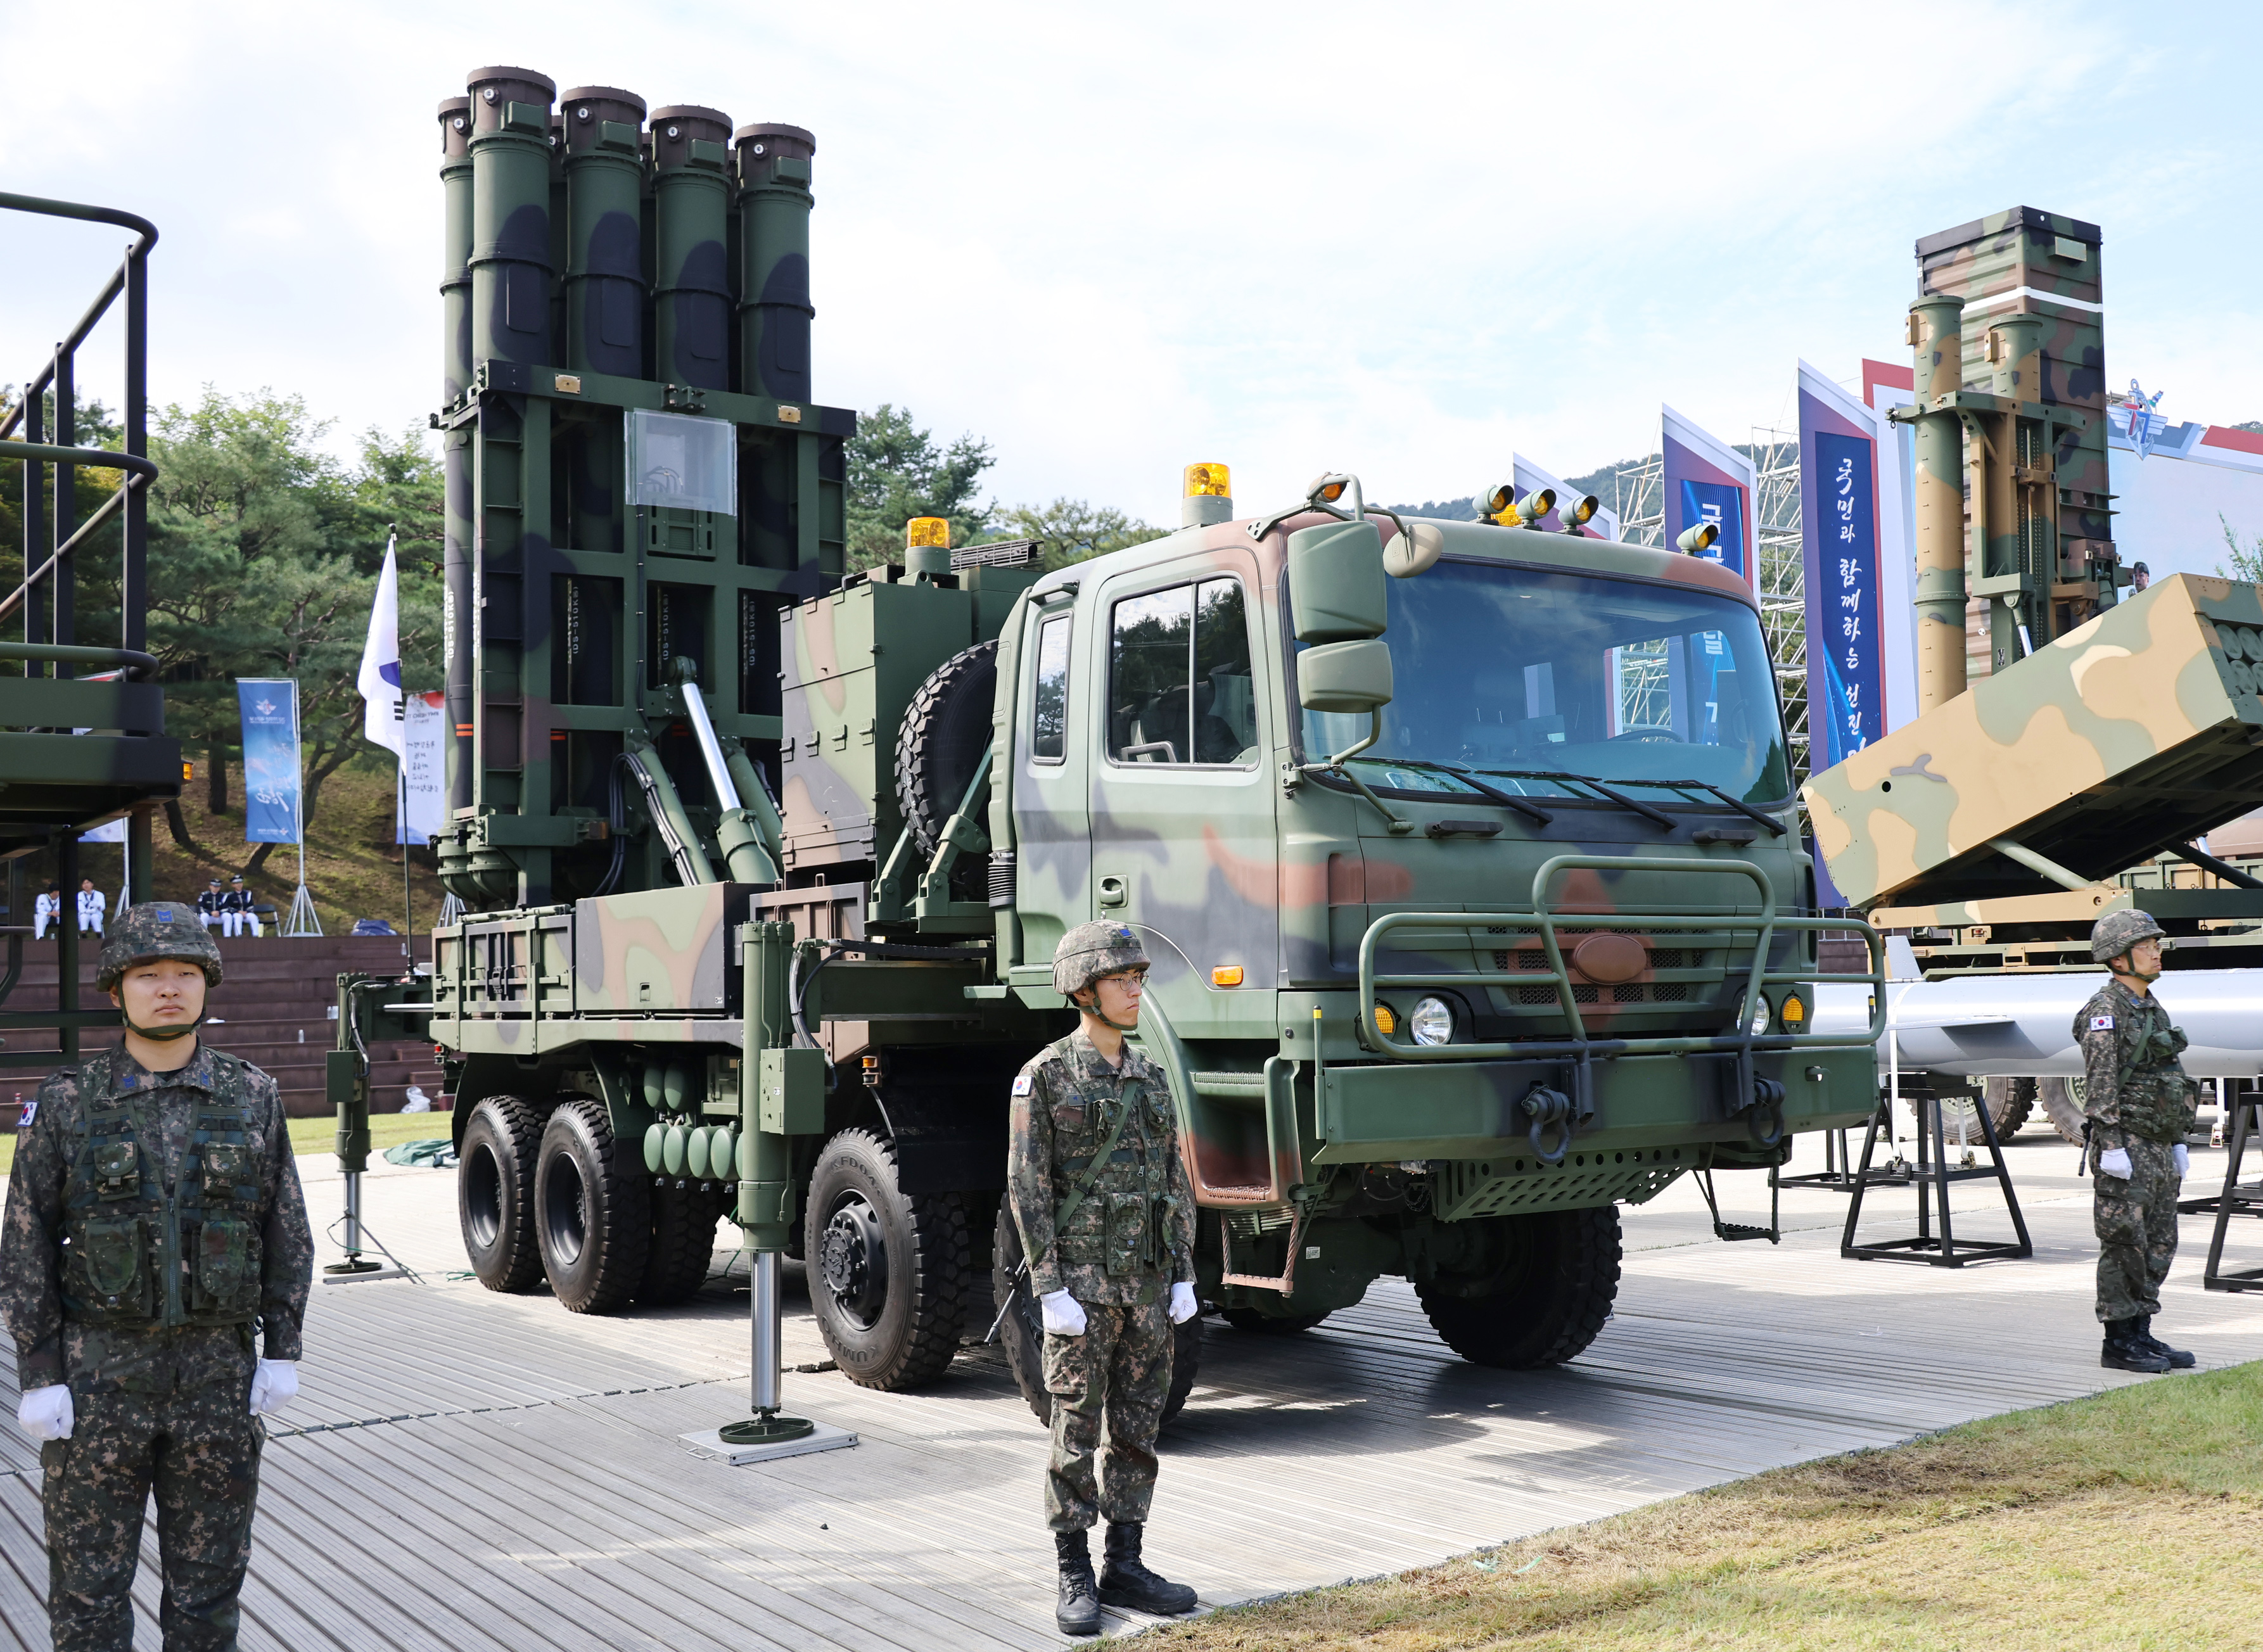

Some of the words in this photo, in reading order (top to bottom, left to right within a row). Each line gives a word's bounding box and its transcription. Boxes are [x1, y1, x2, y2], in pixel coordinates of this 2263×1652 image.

[1836, 457, 1856, 543] 국민과
[1839, 558, 1863, 669] 함께하는
[822, 1316, 877, 1363] KUMHO
